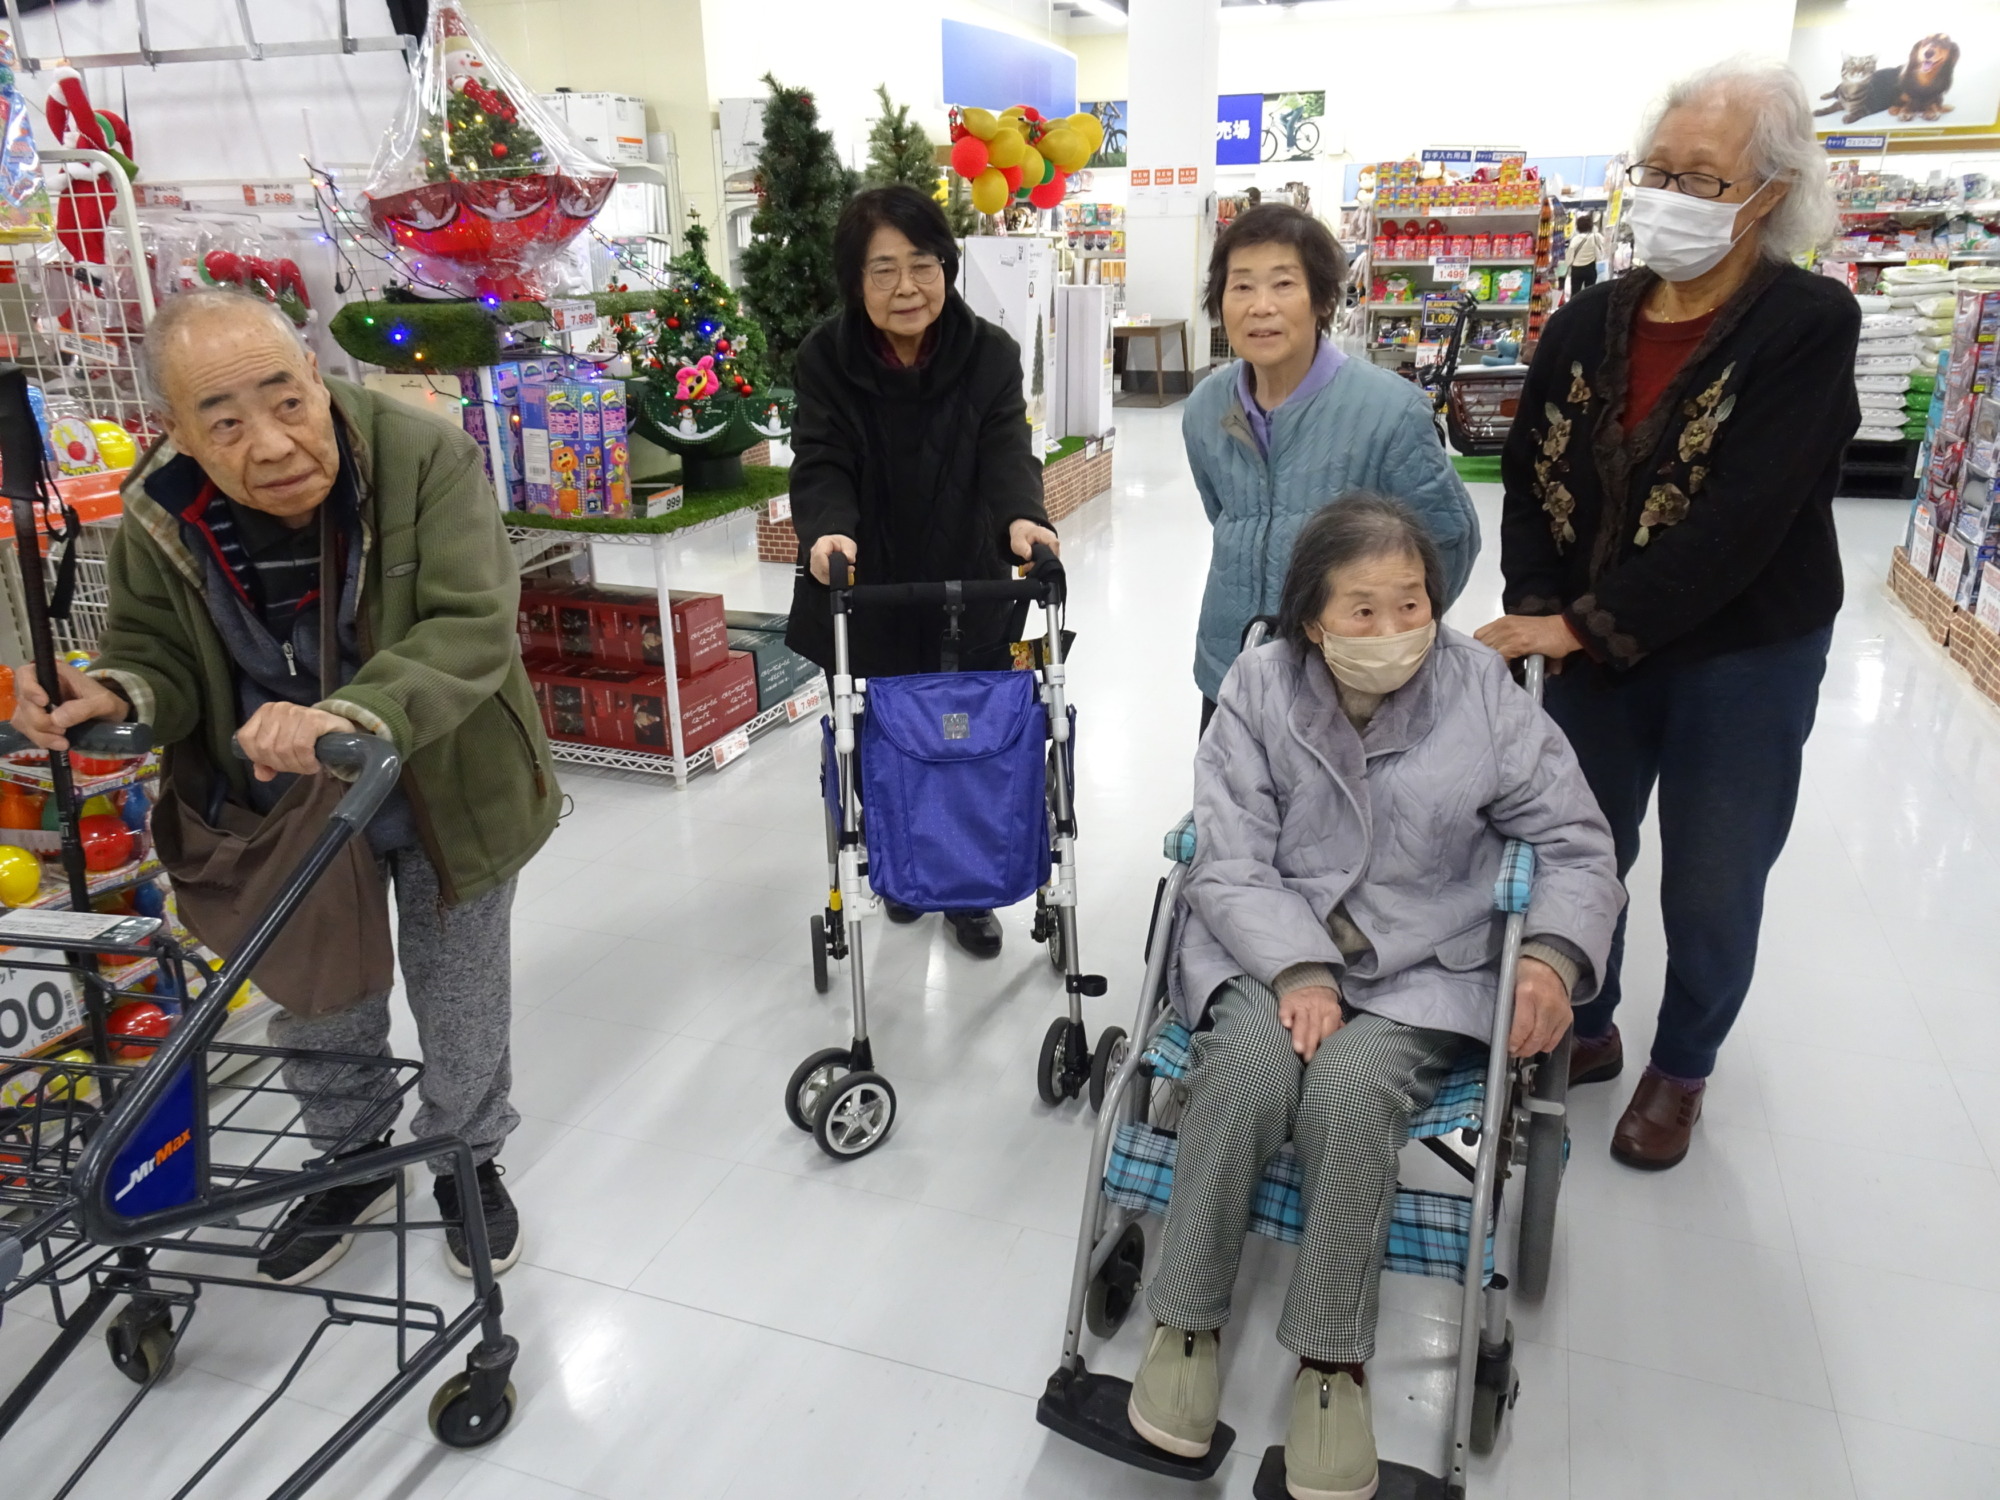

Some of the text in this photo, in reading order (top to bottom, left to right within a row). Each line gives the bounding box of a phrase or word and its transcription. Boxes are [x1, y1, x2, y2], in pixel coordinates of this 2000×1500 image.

[1424, 152, 1469, 160] お手入れ用品
[666, 495, 681, 510] 999
[115, 1128, 191, 1201] MrMax
